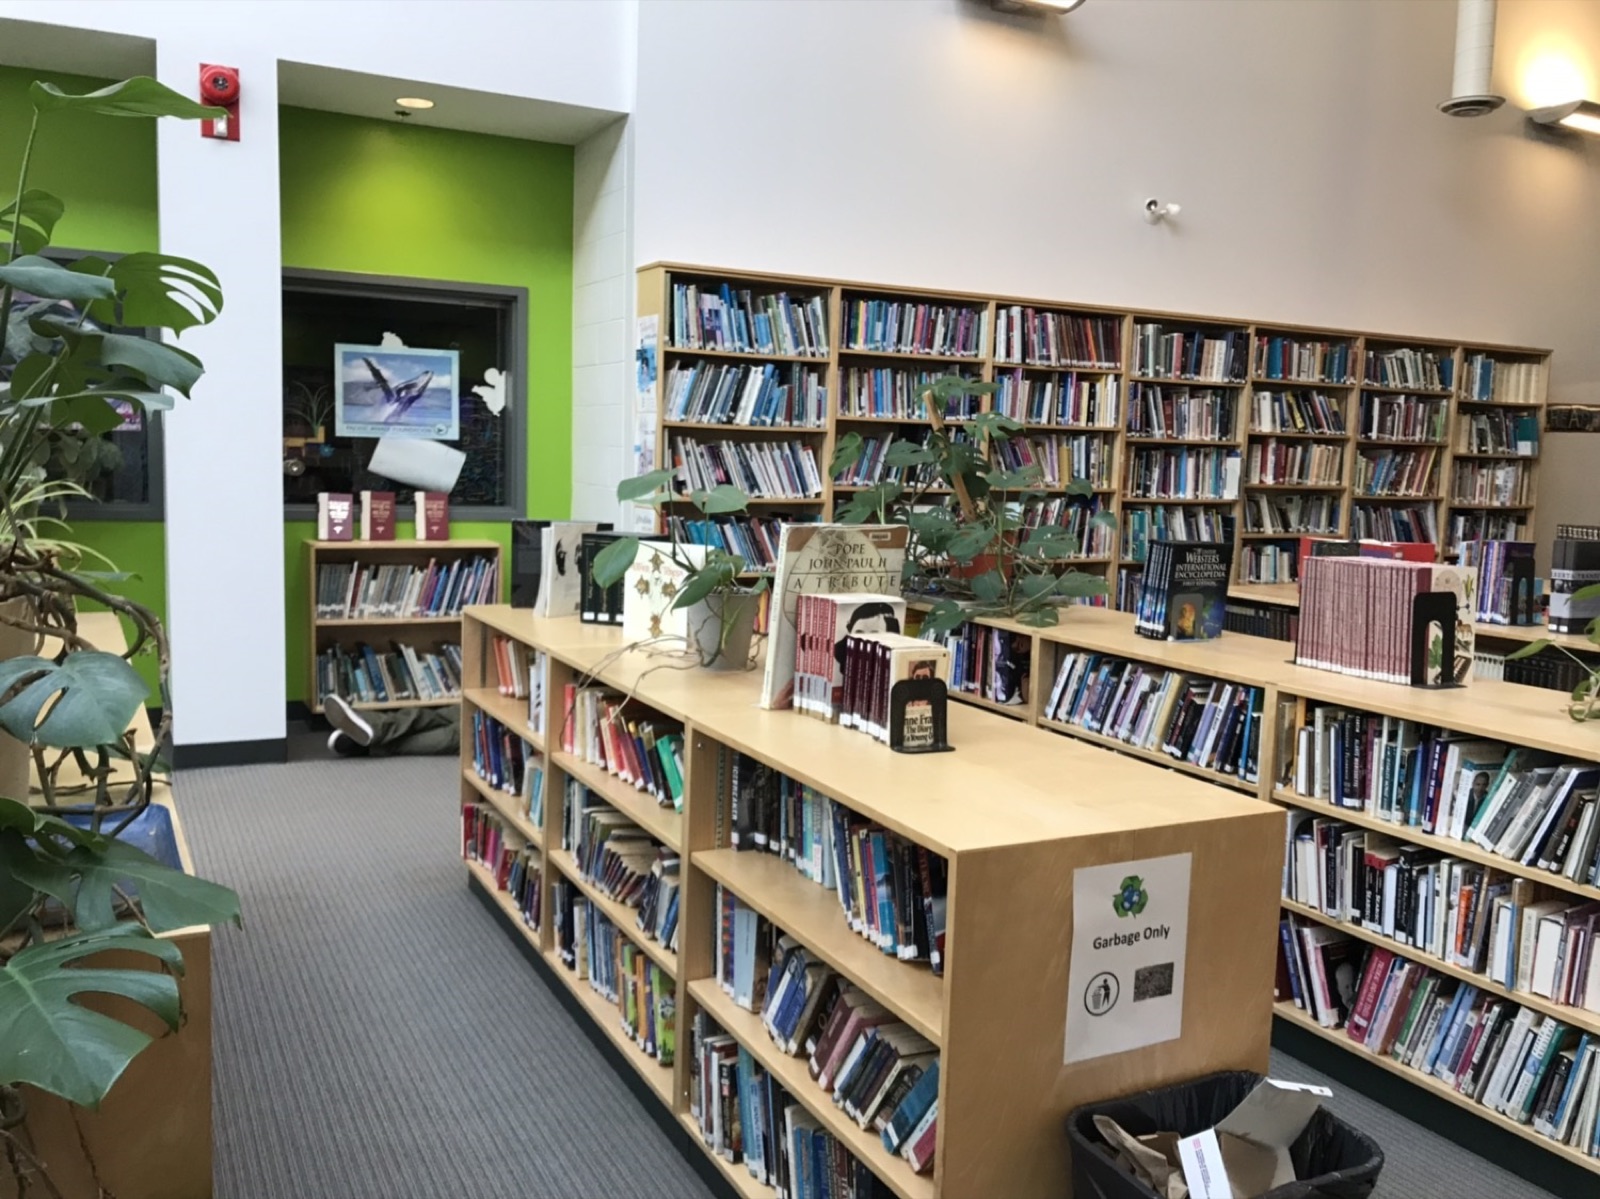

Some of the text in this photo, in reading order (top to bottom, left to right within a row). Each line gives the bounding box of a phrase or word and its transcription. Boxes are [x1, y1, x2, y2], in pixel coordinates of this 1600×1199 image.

[835, 543, 866, 554] POPE
[809, 556, 846, 571] JOHN
[847, 557, 875, 569] PAUL
[1176, 563, 1227, 571] INTERNATIONAL
[793, 575, 897, 589] A TRIBUTE
[904, 714, 933, 726] nne Fra
[906, 725, 917, 734] The
[1093, 924, 1171, 950] Garbage Only
